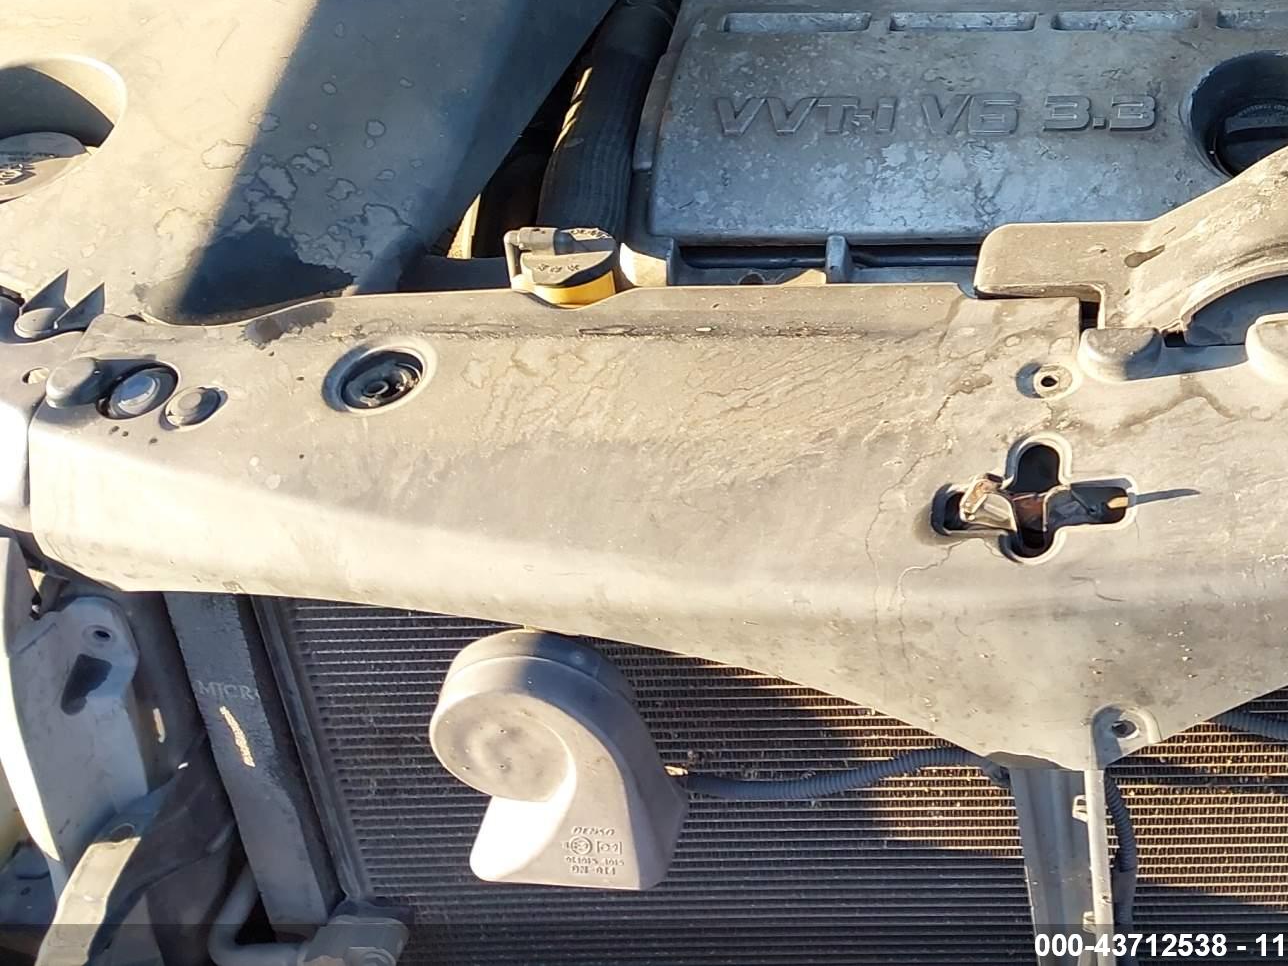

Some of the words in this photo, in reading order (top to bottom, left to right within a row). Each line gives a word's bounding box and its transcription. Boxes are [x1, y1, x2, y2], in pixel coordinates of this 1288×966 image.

[921, 93, 1021, 135] V6
[1041, 94, 1157, 133] 3.3
[571, 826, 616, 836] DENSO
